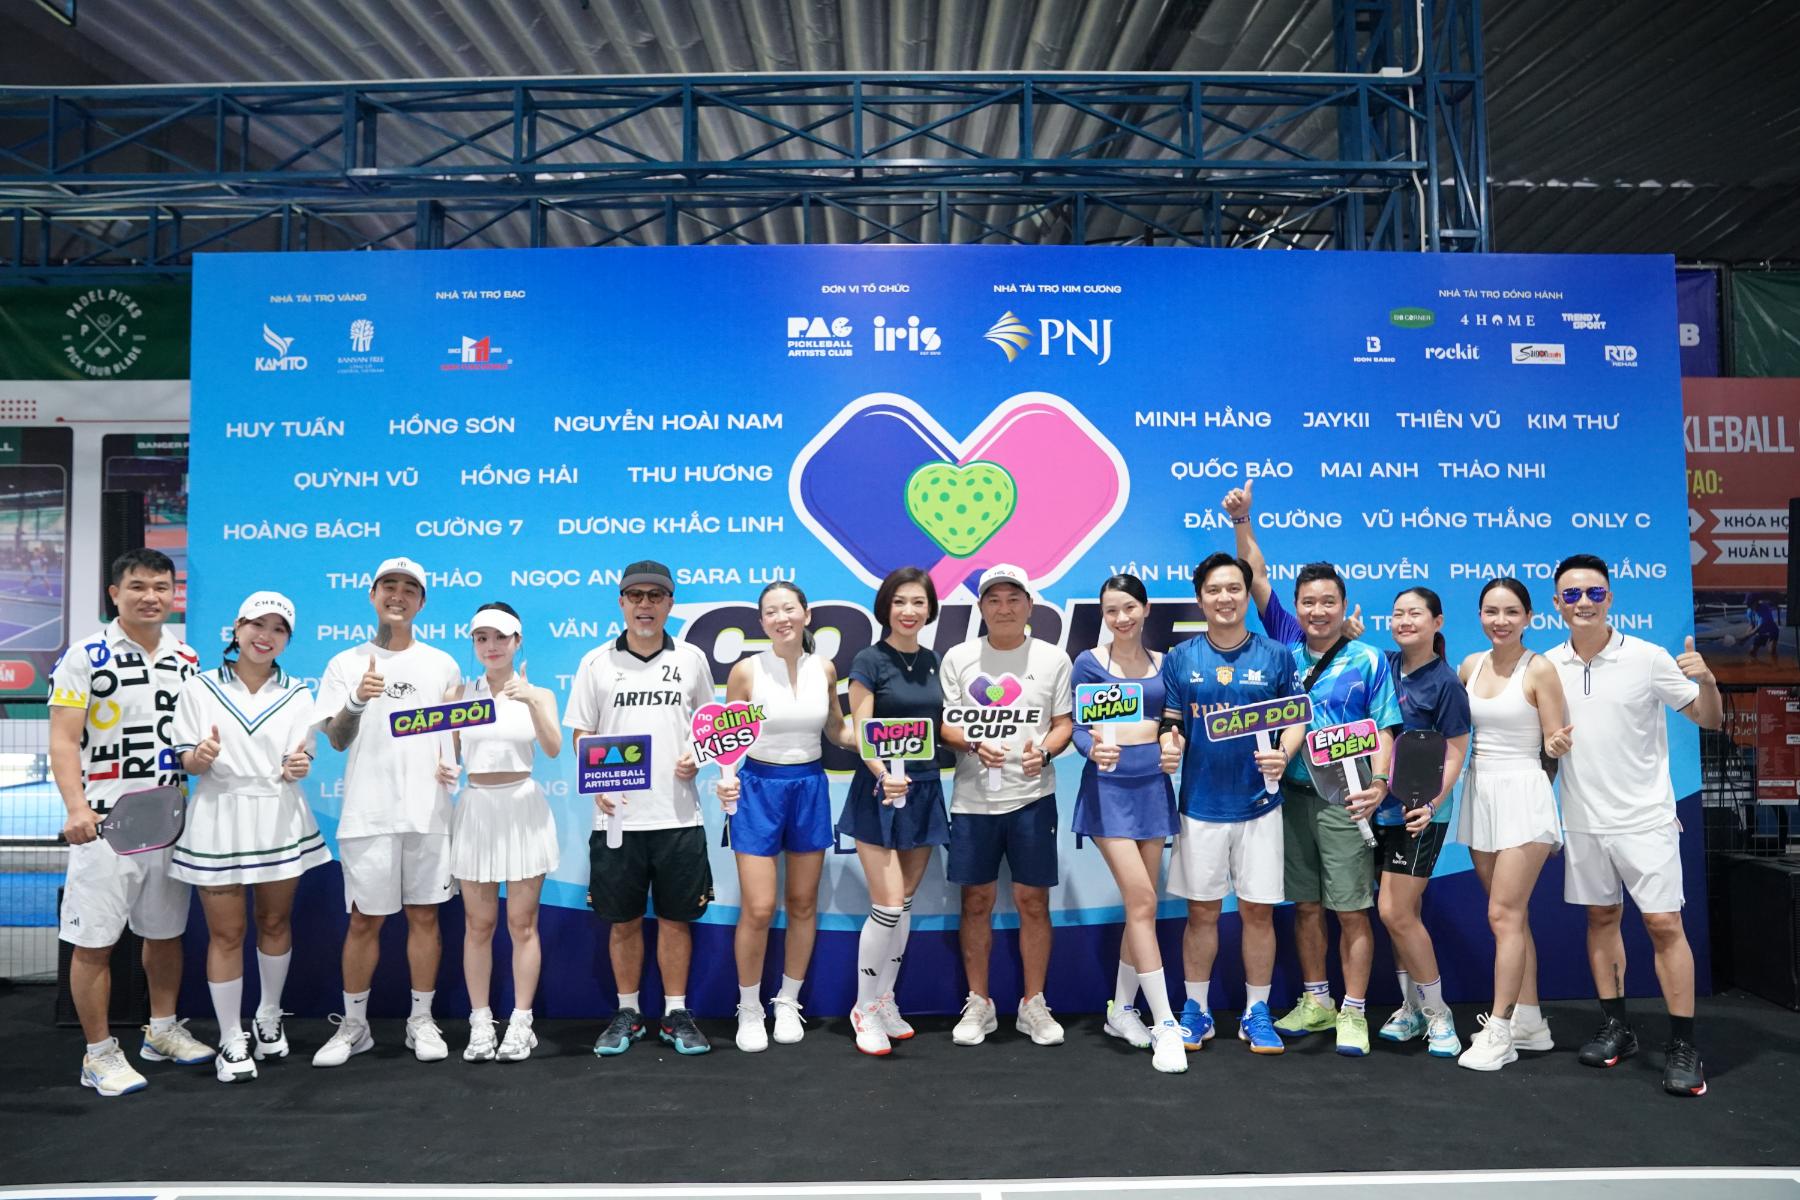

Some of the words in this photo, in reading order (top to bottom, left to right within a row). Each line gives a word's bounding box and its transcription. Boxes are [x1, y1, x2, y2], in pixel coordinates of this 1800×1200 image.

[270, 293, 294, 303] NHÀ
[338, 292, 368, 302] VÀNG
[435, 290, 459, 300] NHÀ
[461, 290, 478, 300] TÀI
[480, 290, 502, 299] TRỢ
[822, 285, 846, 294] ĐƠN
[879, 283, 910, 293] CHỨC
[993, 283, 1018, 293] NHÀ
[1019, 283, 1036, 293] TÀI
[1038, 284, 1060, 294] TRỢ
[1062, 284, 1081, 293] KIM
[1083, 284, 1122, 294] CƯƠNG
[1439, 288, 1461, 298] NHÀ
[1462, 288, 1478, 298] TÀI
[1480, 290, 1501, 299] TRỢ
[1535, 290, 1563, 300] HÀNH
[66, 289, 105, 319] PADEL
[108, 289, 143, 319] PICKS
[1561, 312, 1601, 322] TRENDY
[1572, 321, 1607, 330] SPORT
[873, 315, 942, 352] iris
[1038, 318, 1113, 366] PNJ
[787, 340, 853, 348] PICKLEBALL
[787, 349, 827, 357] ARTISTS
[827, 349, 853, 357] CLUB
[1425, 342, 1480, 360] rockit
[255, 356, 308, 371] KAMITO
[389, 413, 459, 435] HỒNG
[465, 415, 515, 434] SƠN
[554, 408, 654, 432] NGUYỄN
[662, 410, 719, 431] HOÀI
[727, 413, 783, 430] NAM
[1135, 411, 1197, 427] MINH
[1204, 405, 1272, 428] HẰNG
[1302, 411, 1370, 428] JAYKII
[1395, 408, 1463, 429] THIÊN
[1469, 409, 1501, 429] VŨ
[1527, 413, 1567, 430] KIM
[1573, 412, 1620, 430] THƯ
[225, 421, 276, 438] HUY
[280, 416, 345, 437] TUẤN
[1684, 415, 1794, 453] KLEBALL
[293, 467, 379, 491] QUỲNH
[385, 466, 419, 487] VŨ
[460, 463, 531, 486] HỒNG
[538, 463, 578, 484] HẢI
[627, 466, 677, 483] THU
[684, 463, 773, 482] HƯƠNG
[1170, 457, 1238, 481] QUỐC
[1245, 458, 1294, 478] BẢO
[1320, 462, 1362, 478] MAI
[1369, 462, 1419, 478] ANH
[1438, 459, 1500, 479] THẢO
[1507, 463, 1546, 479] NHI
[415, 516, 503, 537] CƯỜNG
[508, 519, 524, 536] 7
[558, 515, 646, 535] DƯƠNG
[653, 510, 721, 534] KHẮC
[727, 515, 784, 533] LINH
[1183, 509, 1234, 531] ĐẶN
[1258, 508, 1343, 529] CƯỜNG
[1361, 508, 1394, 529] VŨ
[1401, 506, 1468, 529] HỒNG
[1472, 506, 1552, 529] THẮNG
[1571, 512, 1629, 529] ONLY
[1634, 512, 1651, 529] C
[1724, 513, 1767, 528] KHÓA
[1770, 516, 1790, 531] HỌ
[223, 519, 309, 540] HOÀNG
[315, 518, 381, 539] BÁCH
[676, 567, 742, 585] SARA
[748, 565, 796, 584] LƯU
[1335, 557, 1429, 580] NGUYỄN
[1450, 563, 1516, 582] PHẠM
[1607, 557, 1667, 579] HẮNG
[511, 569, 581, 589] NGỌC
[587, 569, 622, 586] AN
[548, 617, 599, 638] VĂN
[661, 664, 682, 683] 24
[613, 690, 682, 708] ARTISTA
[450, 702, 491, 727] ĐÔI
[697, 713, 713, 722] no
[713, 704, 767, 731] dink
[946, 709, 1040, 724] COUPLE
[1083, 698, 1138, 721] NHAU
[1265, 700, 1306, 726] ĐÔI
[696, 724, 711, 736] no
[967, 724, 1017, 739] CUP
[1314, 727, 1345, 750] ÊM
[584, 769, 646, 779] PICKLEBALL
[585, 779, 621, 788] ARTISTS
[622, 777, 646, 786] CLUB
